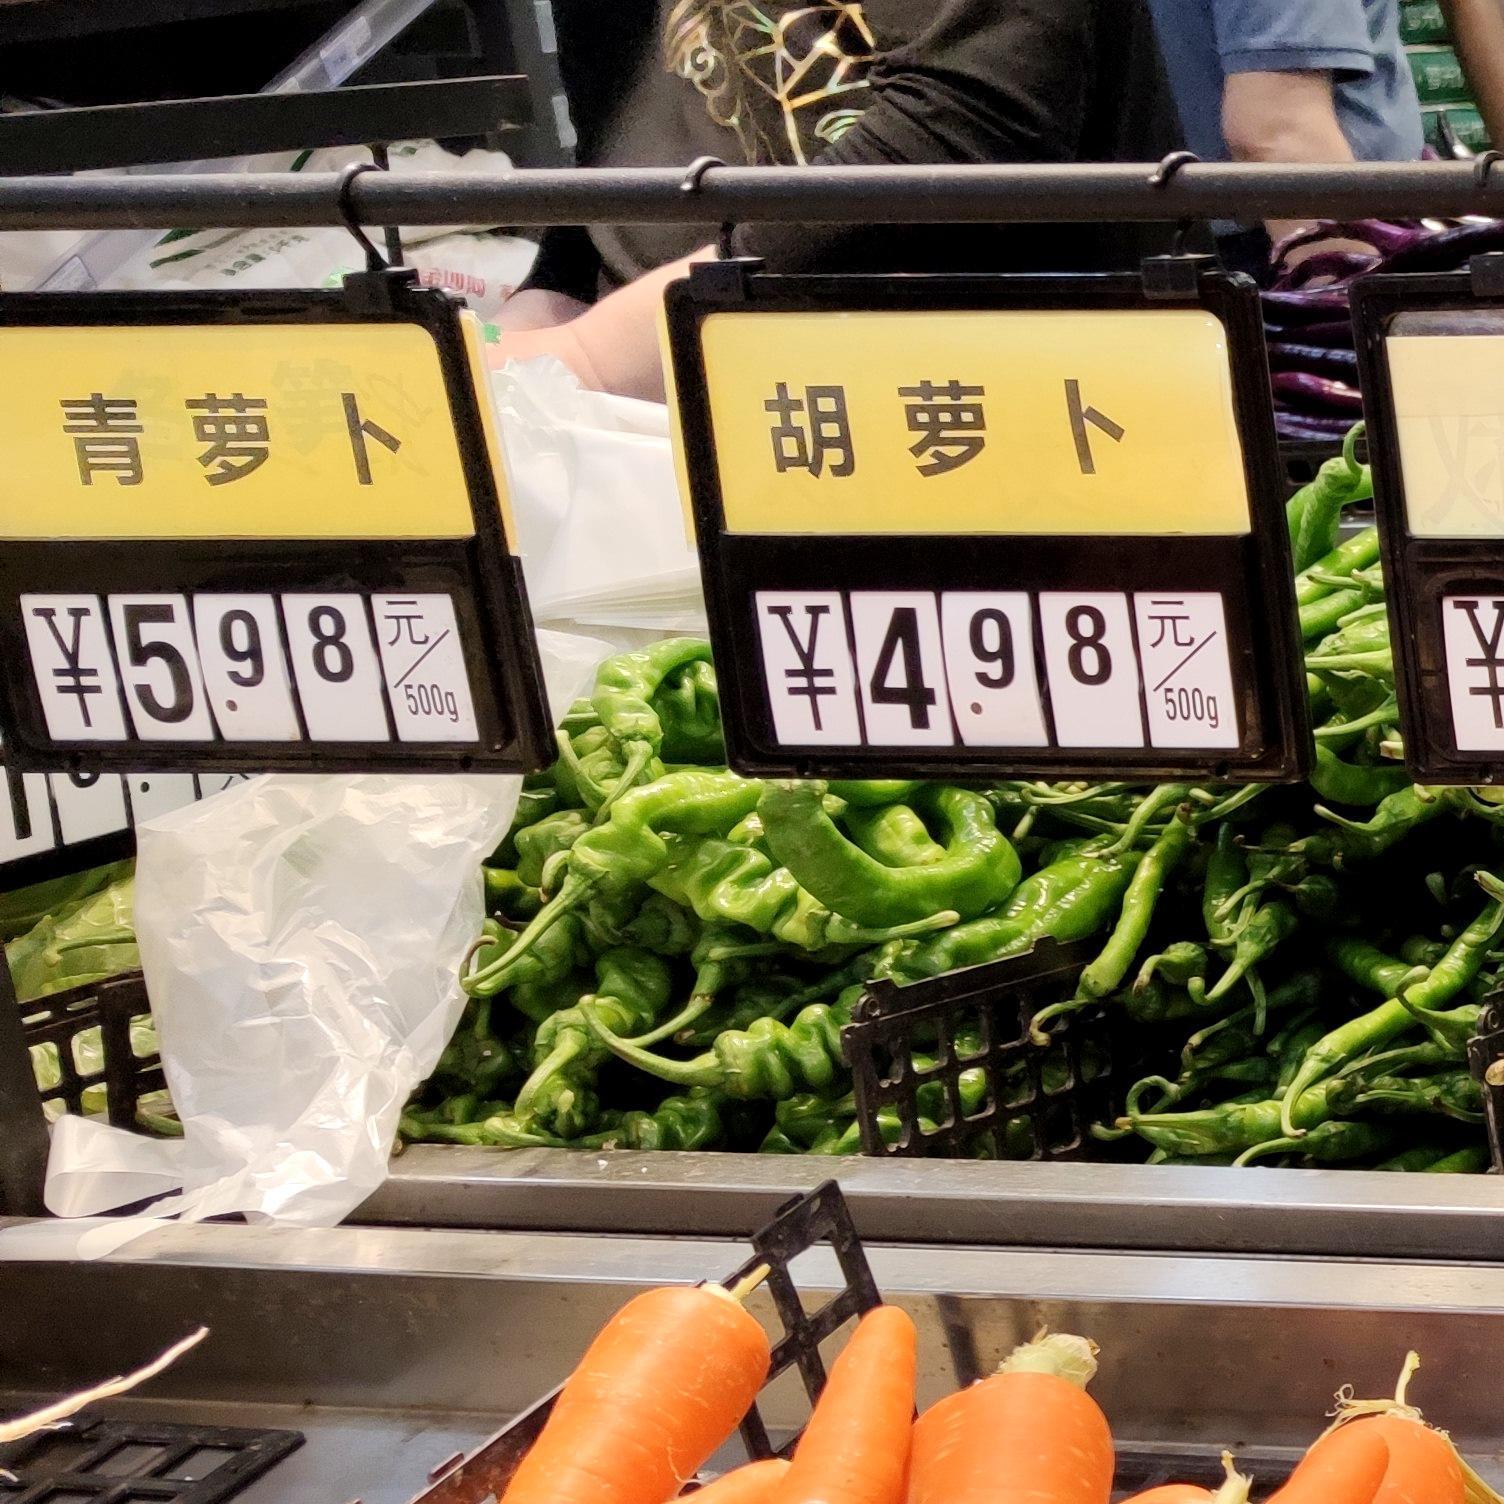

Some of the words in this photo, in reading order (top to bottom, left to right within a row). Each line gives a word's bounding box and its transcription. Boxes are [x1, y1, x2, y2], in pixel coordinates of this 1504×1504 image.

[58, 393, 403, 486] 青萝卜
[763, 379, 1126, 479] 胡萝卜
[32, 602, 357, 728] ¥5.98
[767, 603, 1114, 733] ¥4.98
